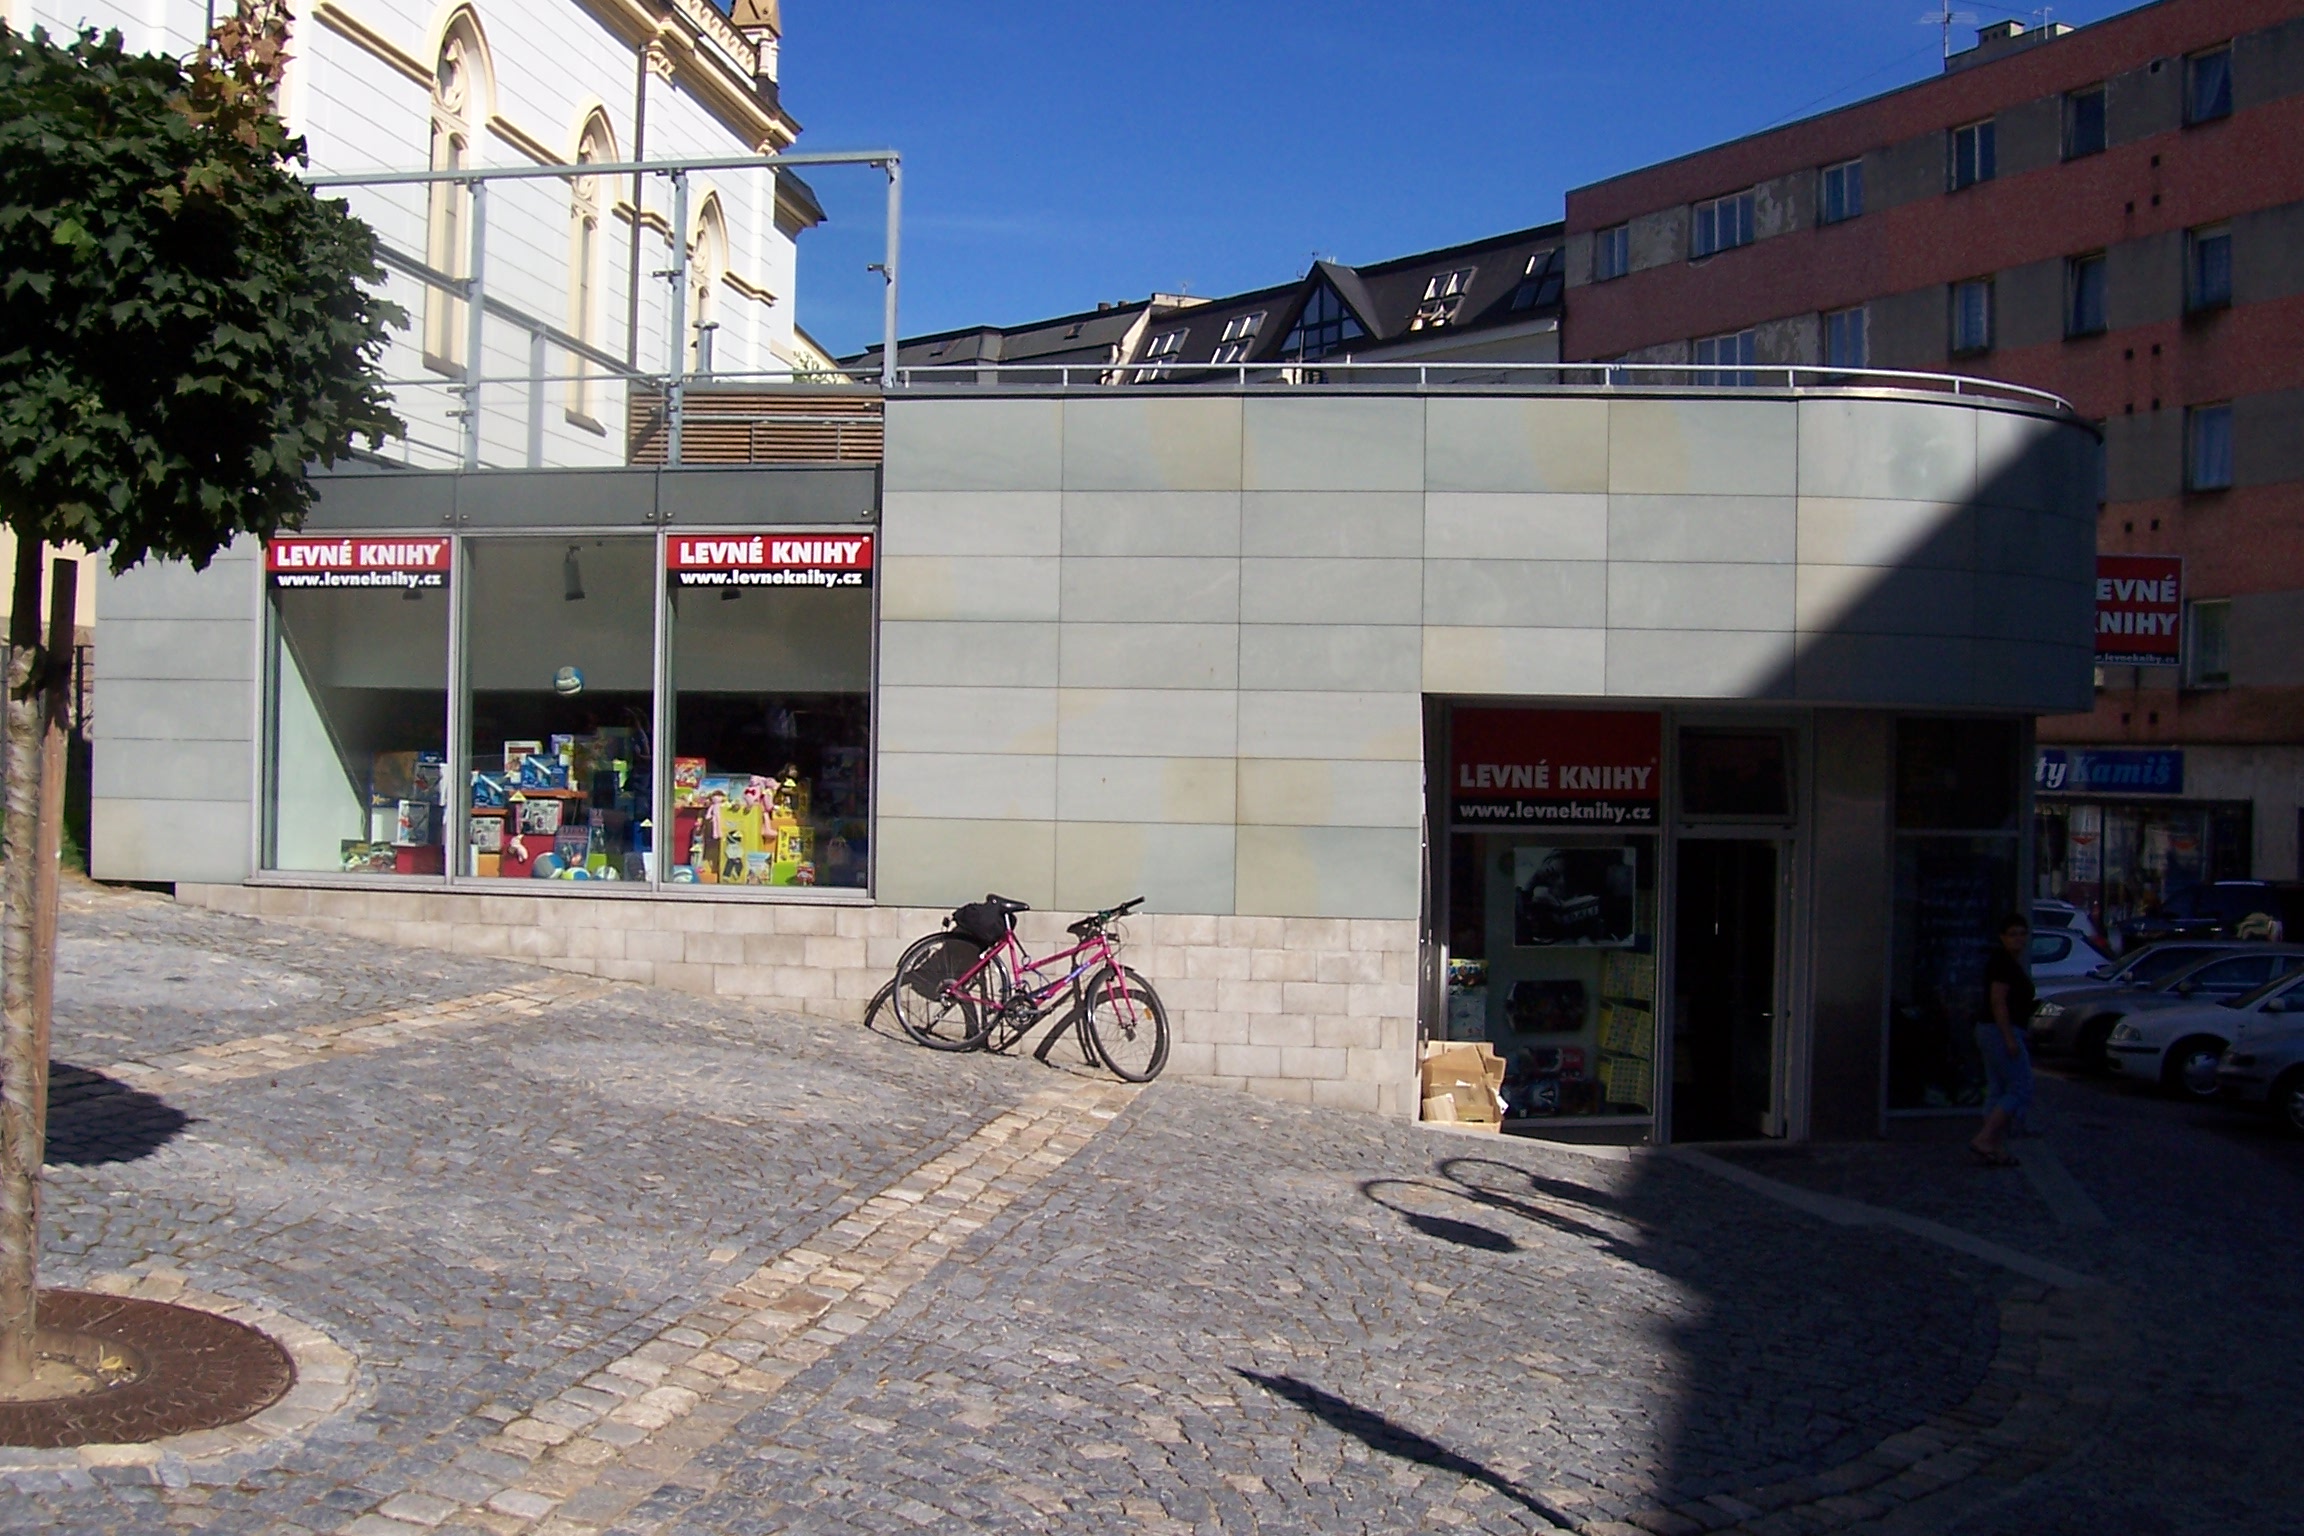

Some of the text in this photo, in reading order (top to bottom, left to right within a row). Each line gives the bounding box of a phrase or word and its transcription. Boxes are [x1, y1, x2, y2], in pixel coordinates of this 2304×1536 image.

[277, 540, 441, 566] LEVNÉ KNIHY
[680, 536, 862, 564] LEVNÉ KNIHY
[277, 571, 442, 588] www.levneknihy.cz
[680, 569, 863, 588] www.levneknihy.cz
[2096, 573, 2177, 603] EVNÉ
[2095, 610, 2178, 635] NIHY
[1459, 758, 1652, 790] LEVNÉ KNIHY
[2034, 755, 2067, 788] ty
[1459, 800, 1652, 823] www.levneknihy.cz
